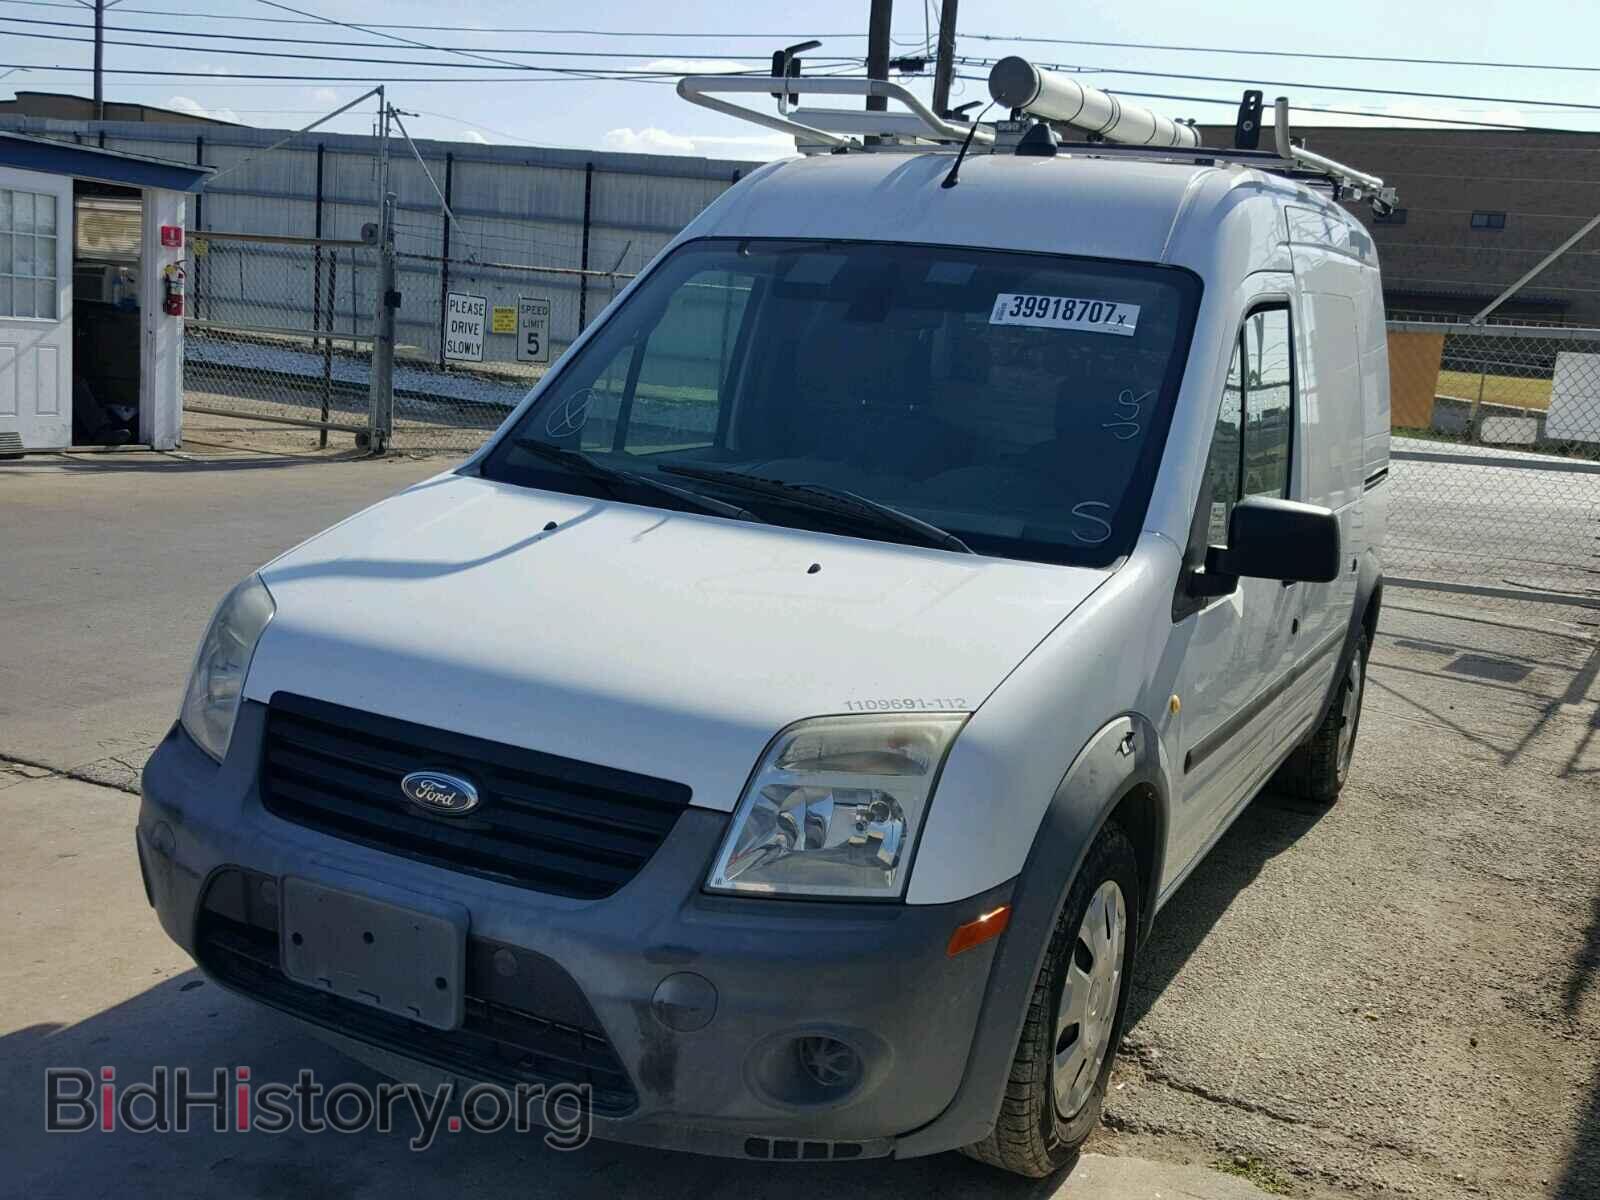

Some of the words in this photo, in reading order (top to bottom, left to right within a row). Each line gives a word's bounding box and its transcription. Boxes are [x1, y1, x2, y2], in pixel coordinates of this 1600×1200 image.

[449, 299, 484, 317] PLEASE
[521, 304, 548, 316] SPEED
[1009, 295, 1117, 323] 39918707
[451, 320, 480, 336] DRIVE
[522, 320, 545, 329] LIMIT
[447, 341, 482, 355] SLOWLY
[527, 333, 540, 355] 5
[843, 697, 968, 711] 1109691-112
[415, 779, 457, 806] Ford
